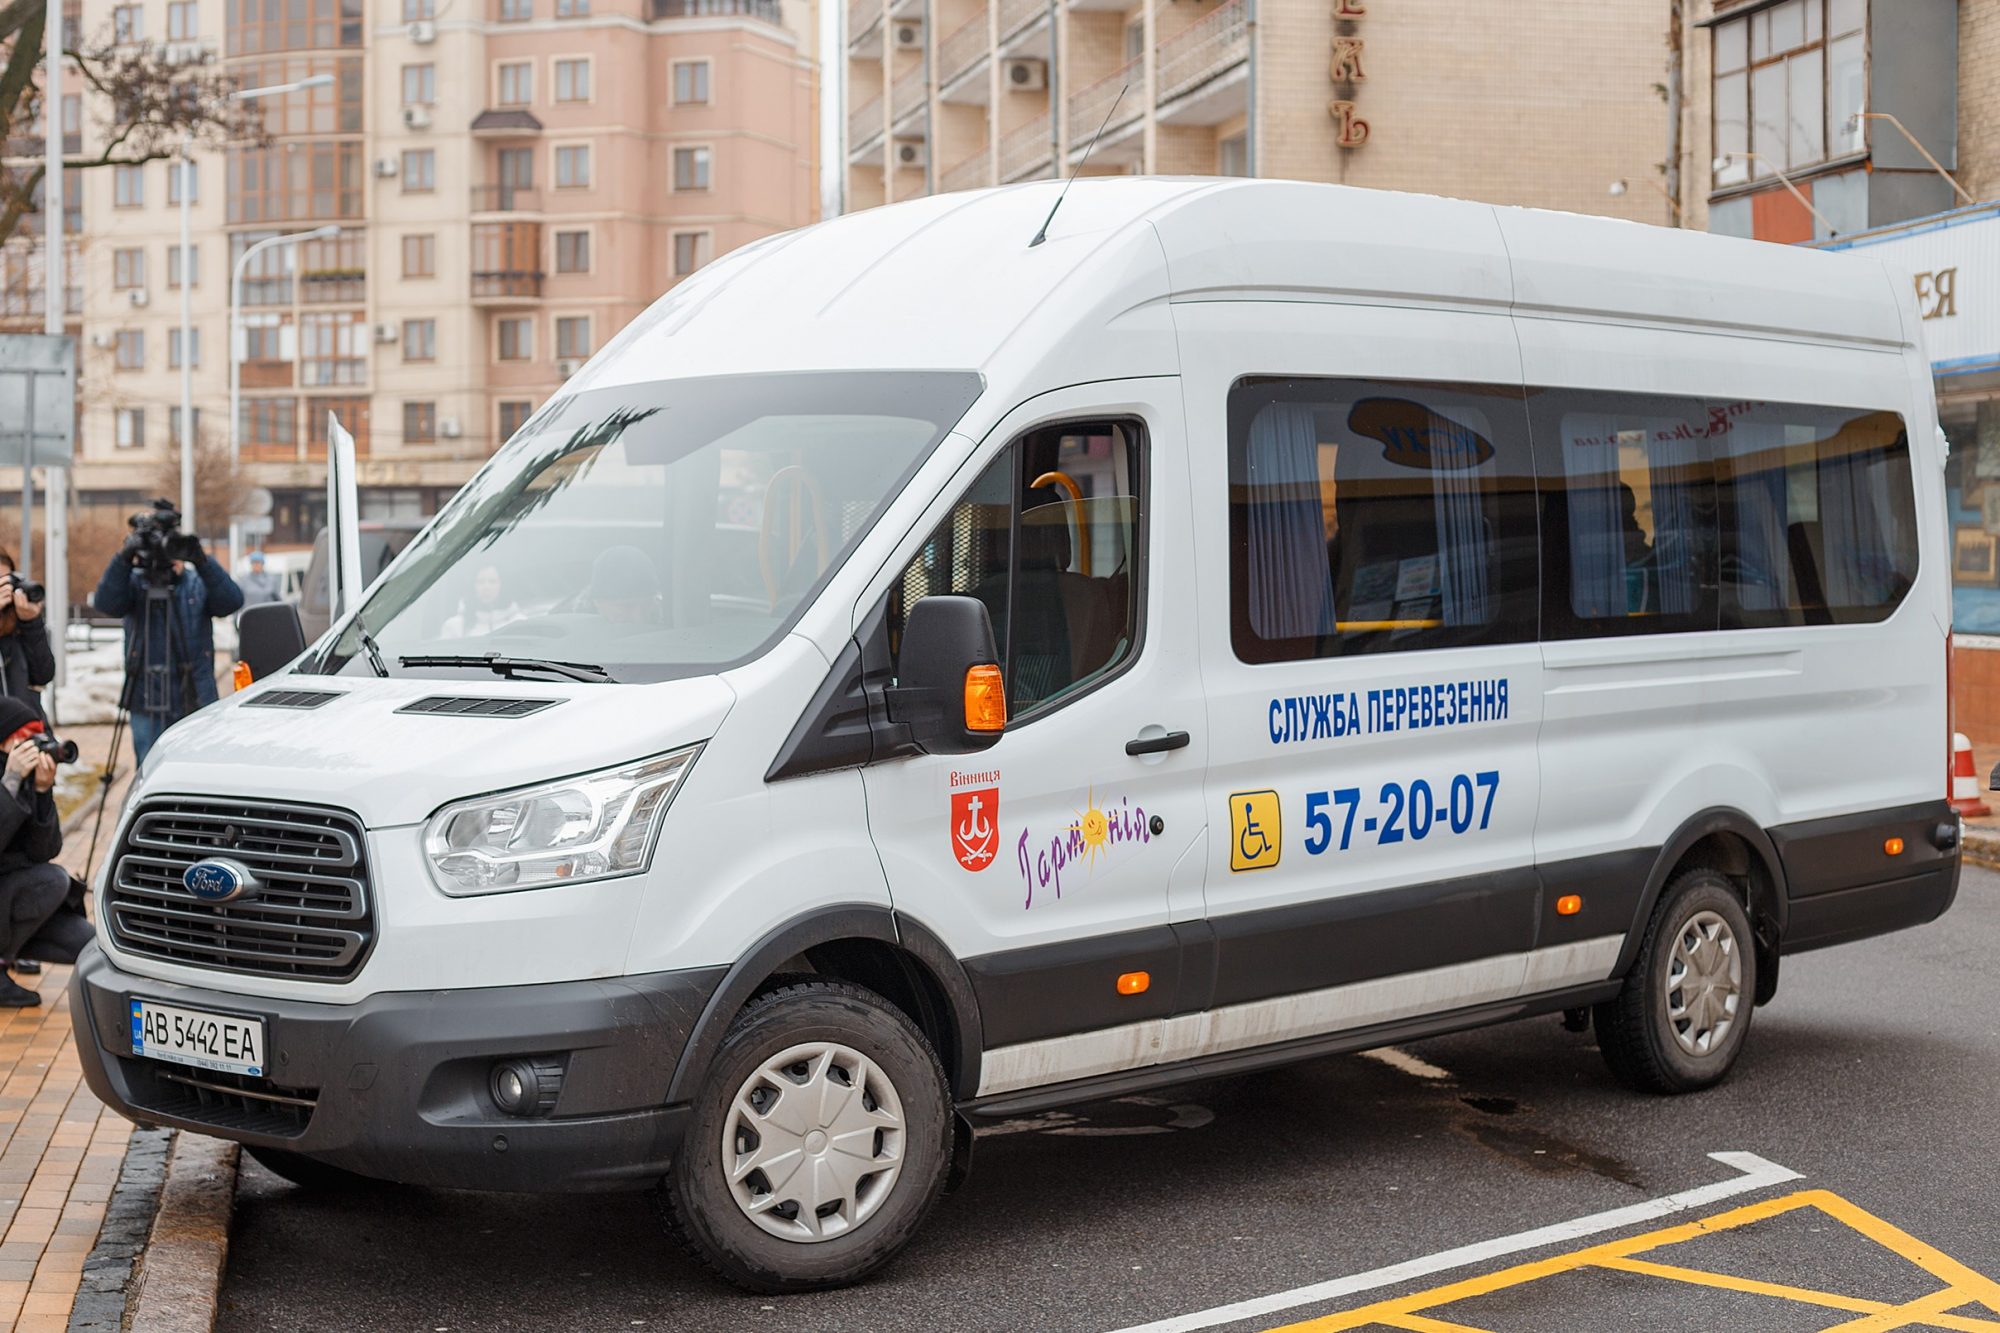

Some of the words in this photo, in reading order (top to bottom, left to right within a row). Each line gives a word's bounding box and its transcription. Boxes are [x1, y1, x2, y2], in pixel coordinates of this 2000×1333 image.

[1268, 692, 1361, 744] СЛУЖБА
[1367, 678, 1509, 735] ПЕРЕВЕЗЕННЯ
[950, 770, 1001, 787] Вінниця
[1304, 770, 1500, 855] 57-20-07
[191, 867, 224, 892] Ford
[134, 1029, 142, 1040] UA
[144, 1010, 169, 1045] AB
[174, 1015, 219, 1056] 5442
[224, 1024, 256, 1062] EA
